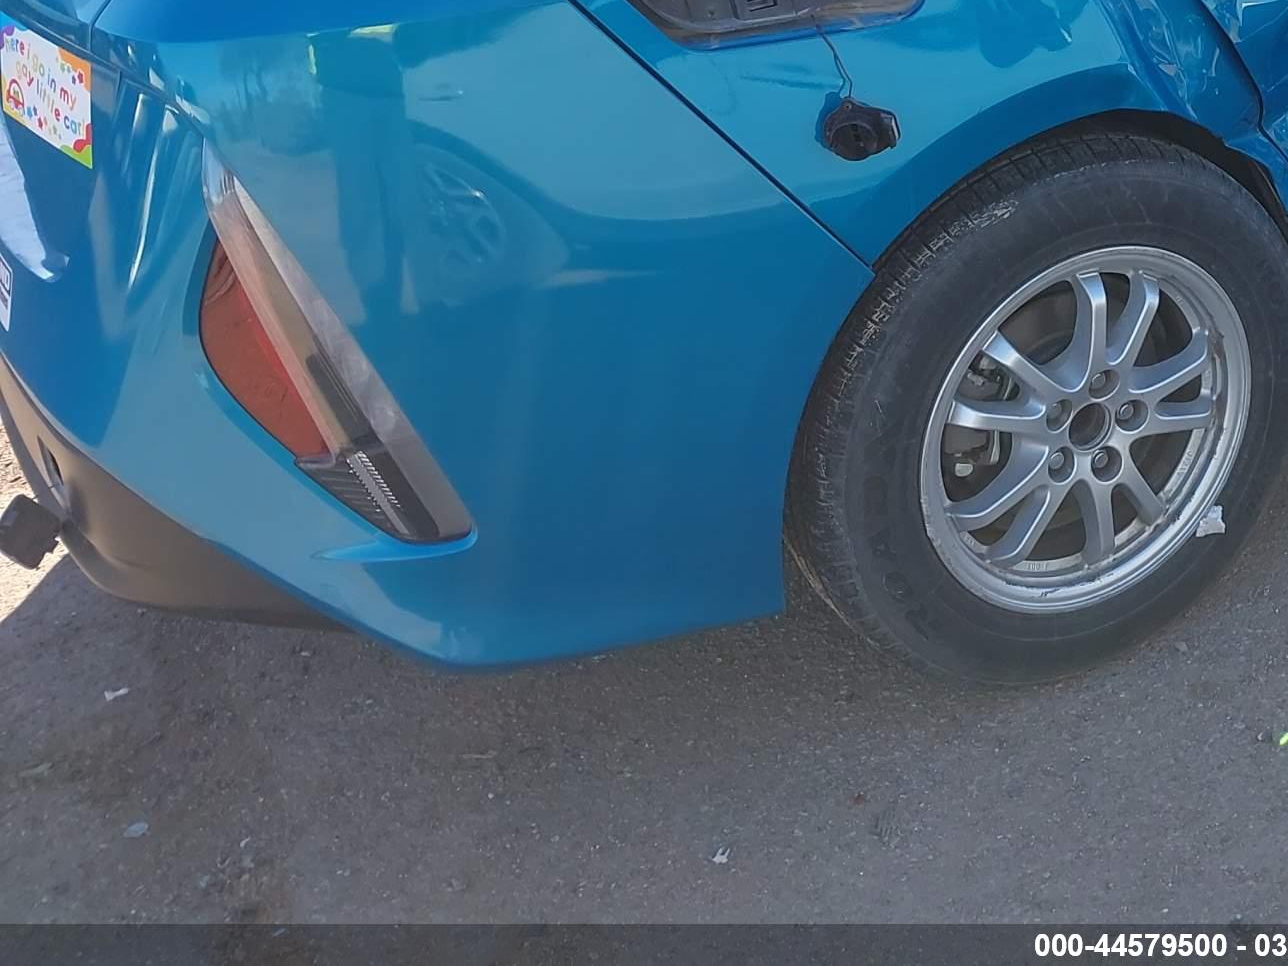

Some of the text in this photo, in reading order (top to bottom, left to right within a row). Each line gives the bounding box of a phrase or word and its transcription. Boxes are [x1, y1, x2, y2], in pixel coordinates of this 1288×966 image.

[15, 60, 34, 87] gay
[36, 78, 61, 122] little
[32, 52, 45, 74] go
[47, 68, 57, 91] in
[59, 86, 77, 111] my
